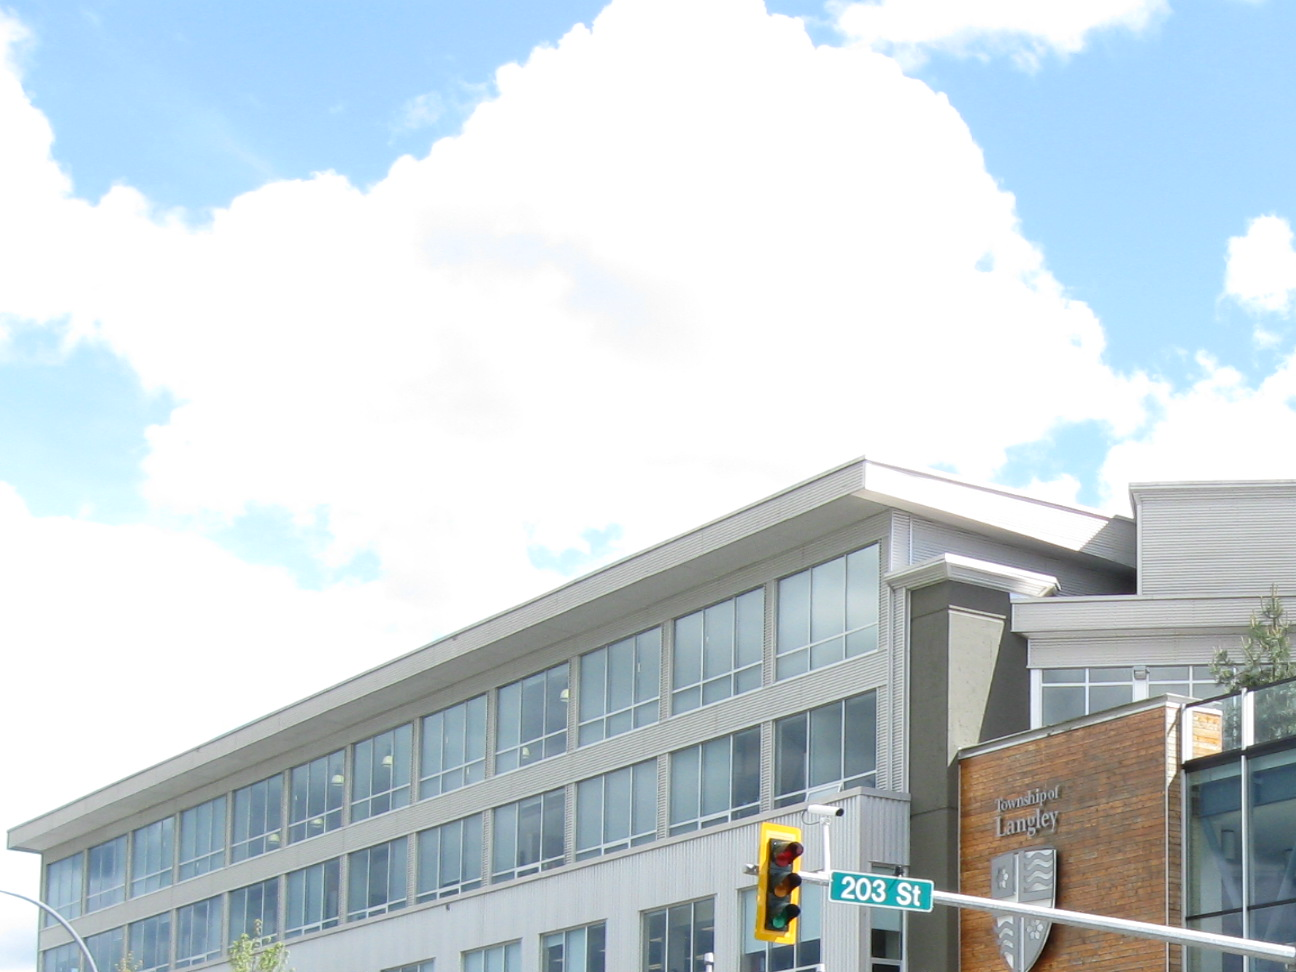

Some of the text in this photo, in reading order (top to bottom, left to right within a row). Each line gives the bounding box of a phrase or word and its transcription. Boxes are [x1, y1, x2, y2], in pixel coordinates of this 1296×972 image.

[995, 785, 1060, 812] Township of
[995, 808, 1059, 837] Langley
[840, 876, 921, 907] 203 St
